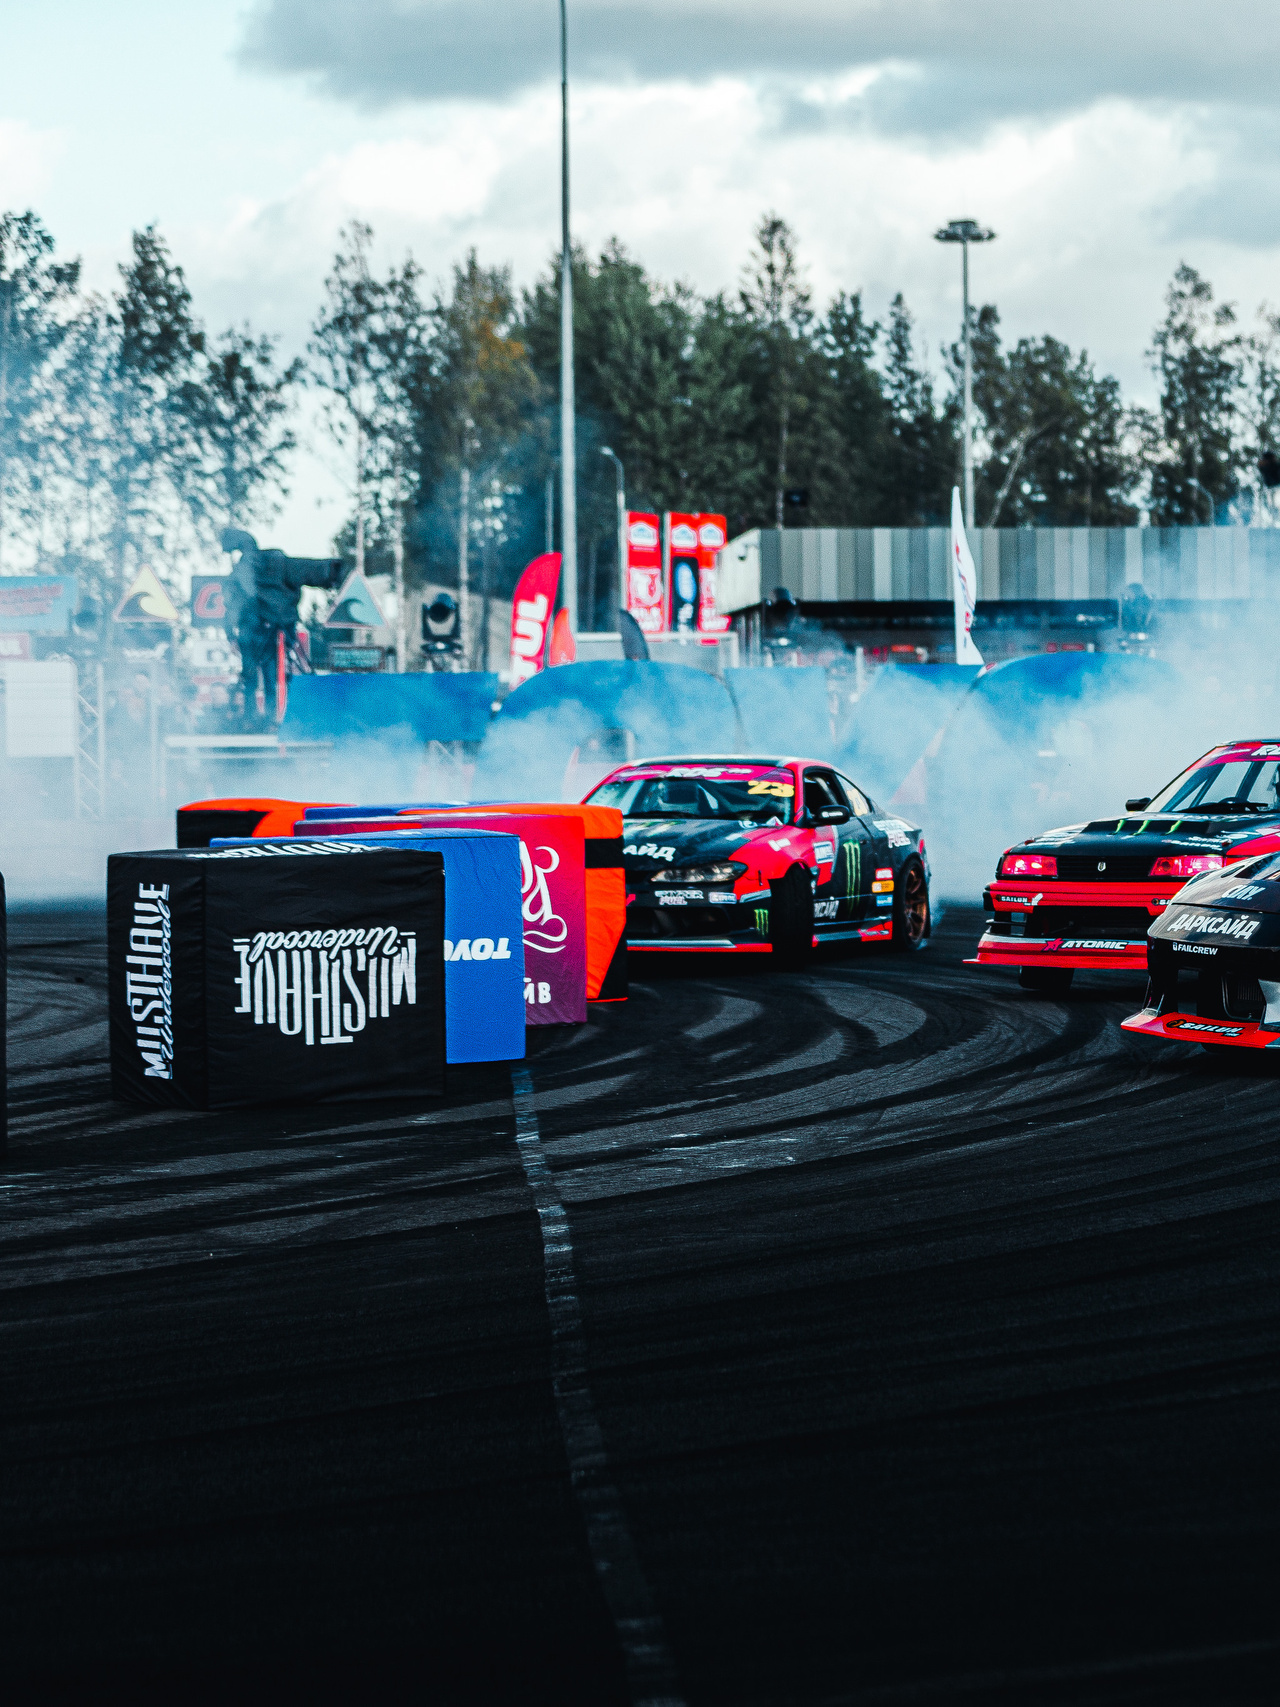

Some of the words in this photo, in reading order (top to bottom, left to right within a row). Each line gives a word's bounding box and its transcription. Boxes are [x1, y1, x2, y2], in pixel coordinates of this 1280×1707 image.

[511, 594, 548, 690] TUL
[748, 780, 795, 797] 23
[1001, 895, 1028, 903] SAILUN
[1167, 914, 1260, 940] ДАРКСАЙД
[1061, 940, 1129, 951] ATOMIC
[1177, 943, 1218, 956] FAILCREW
[126, 882, 173, 1080] MUSTHAVE
[233, 939, 416, 1045] MUSTHAVE
[1179, 1022, 1244, 1033] SAILUN
